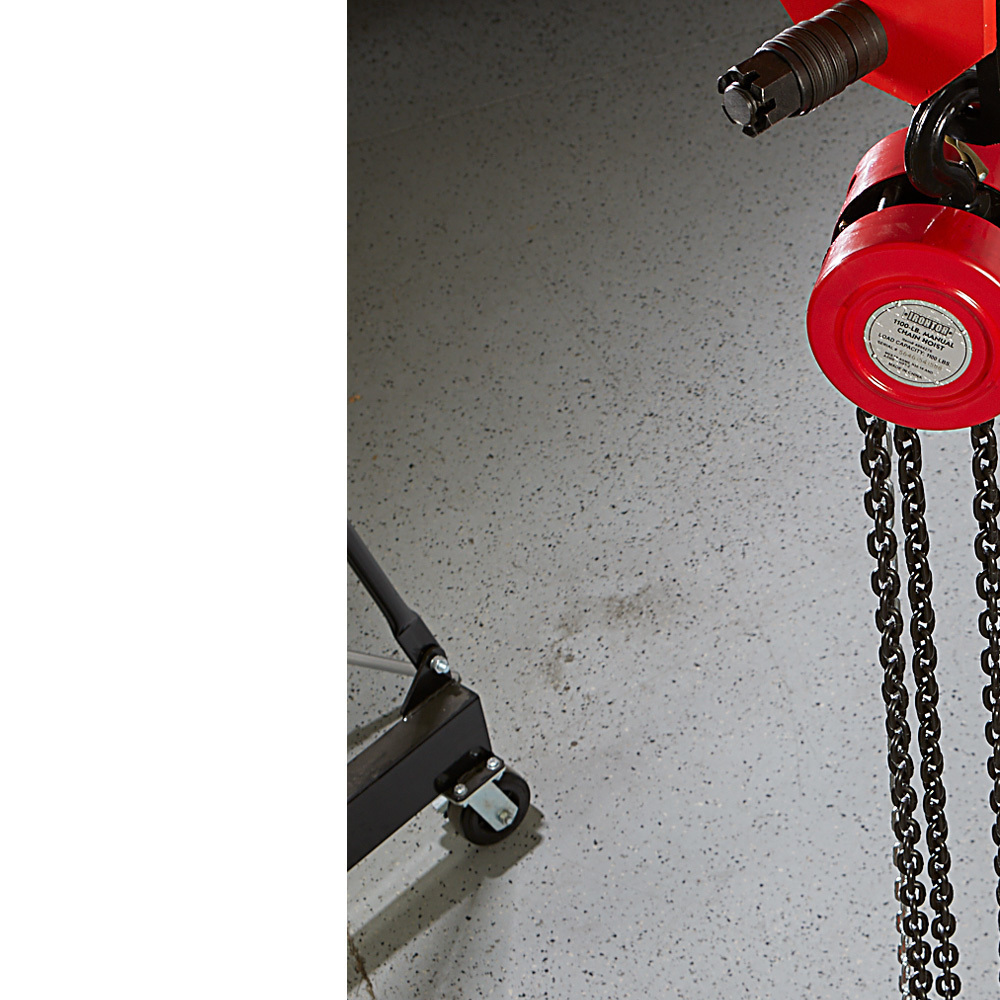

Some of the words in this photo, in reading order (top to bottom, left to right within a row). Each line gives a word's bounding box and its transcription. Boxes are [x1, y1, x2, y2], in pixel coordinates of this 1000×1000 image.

[893, 319, 921, 334] 1100-LB.
[923, 331, 954, 348] MANUAL
[906, 311, 950, 336] IRONTON
[878, 332, 895, 343] LOAD
[895, 339, 925, 357] CAPACITY:
[897, 327, 920, 341] CHAIN
[922, 337, 945, 351] HOIST
